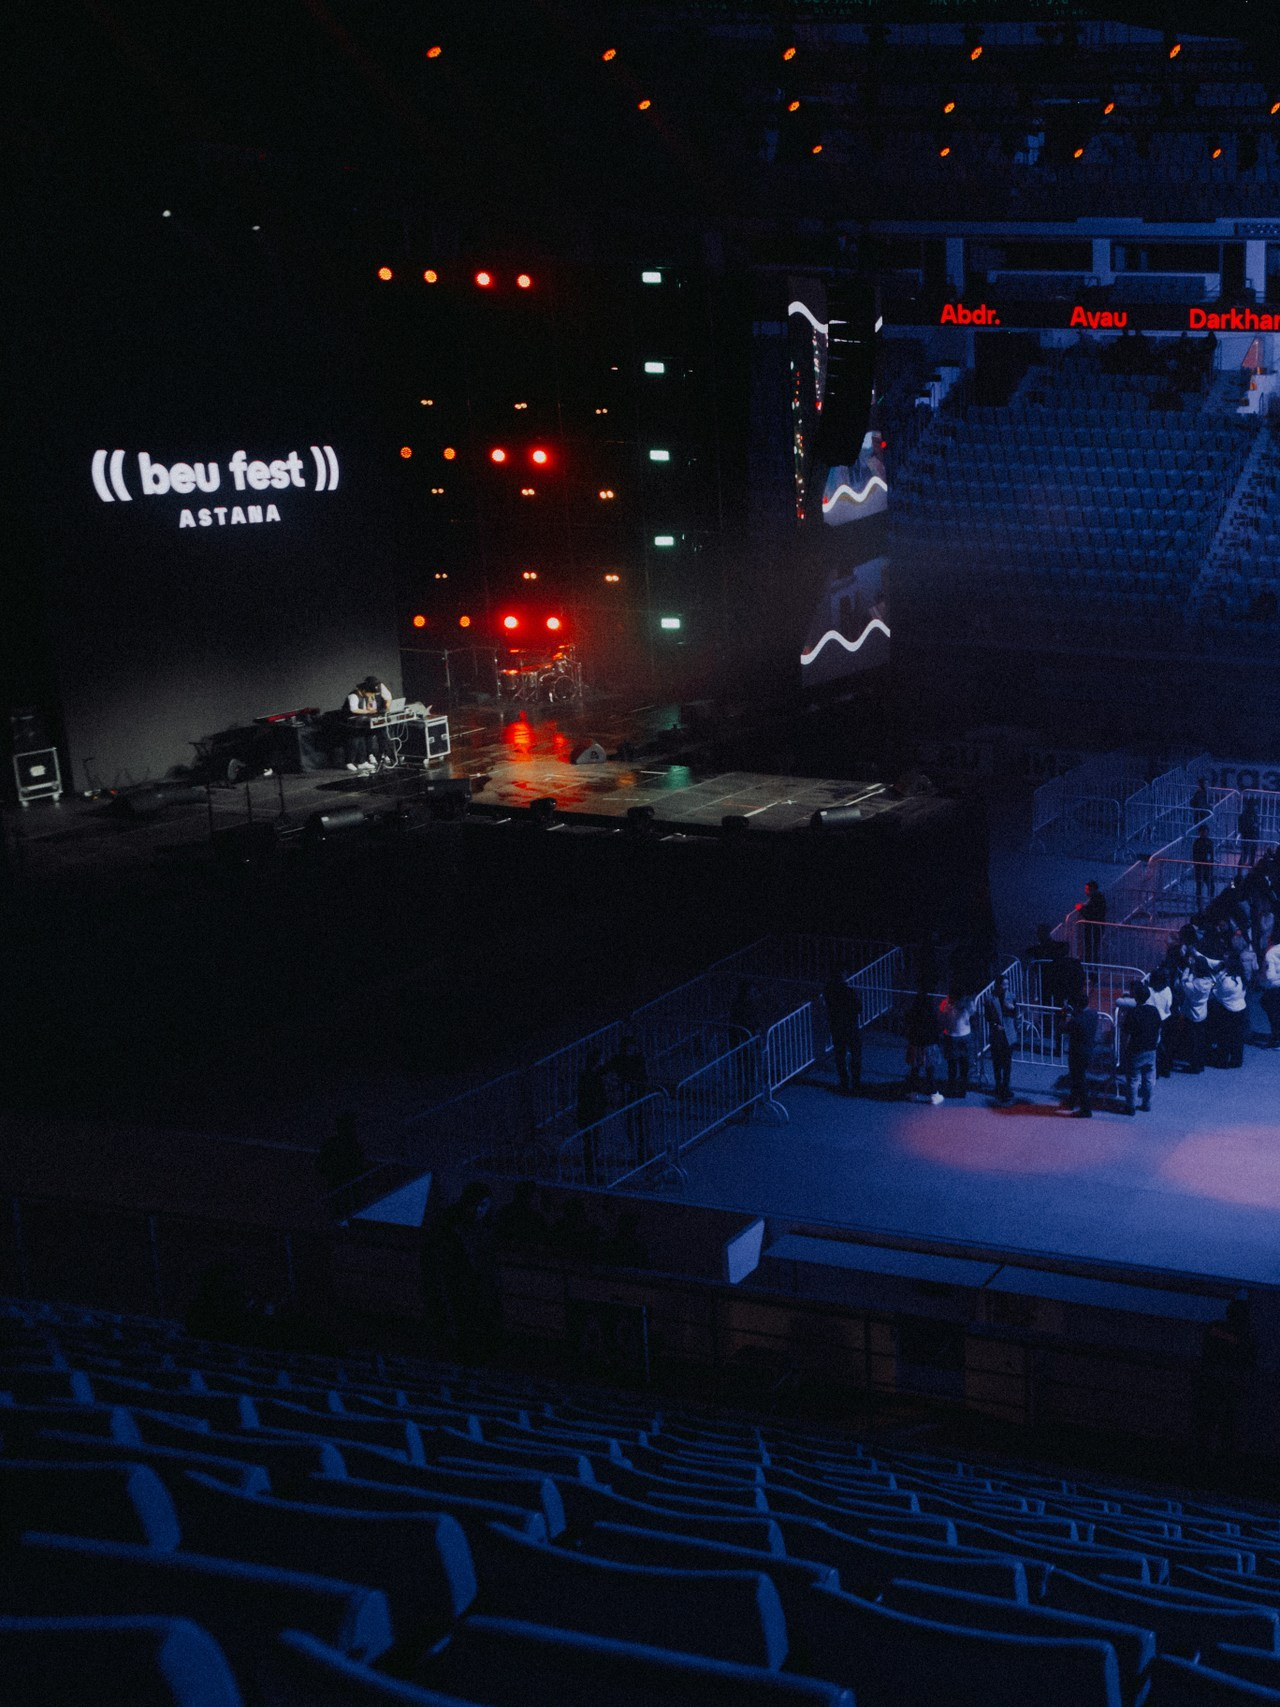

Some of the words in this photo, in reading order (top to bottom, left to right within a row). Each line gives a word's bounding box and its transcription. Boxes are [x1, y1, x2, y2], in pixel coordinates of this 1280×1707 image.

[940, 304, 1001, 325] Abdr.
[138, 451, 221, 495] beu
[229, 449, 306, 491] fest
[179, 504, 281, 529] ASTANA
